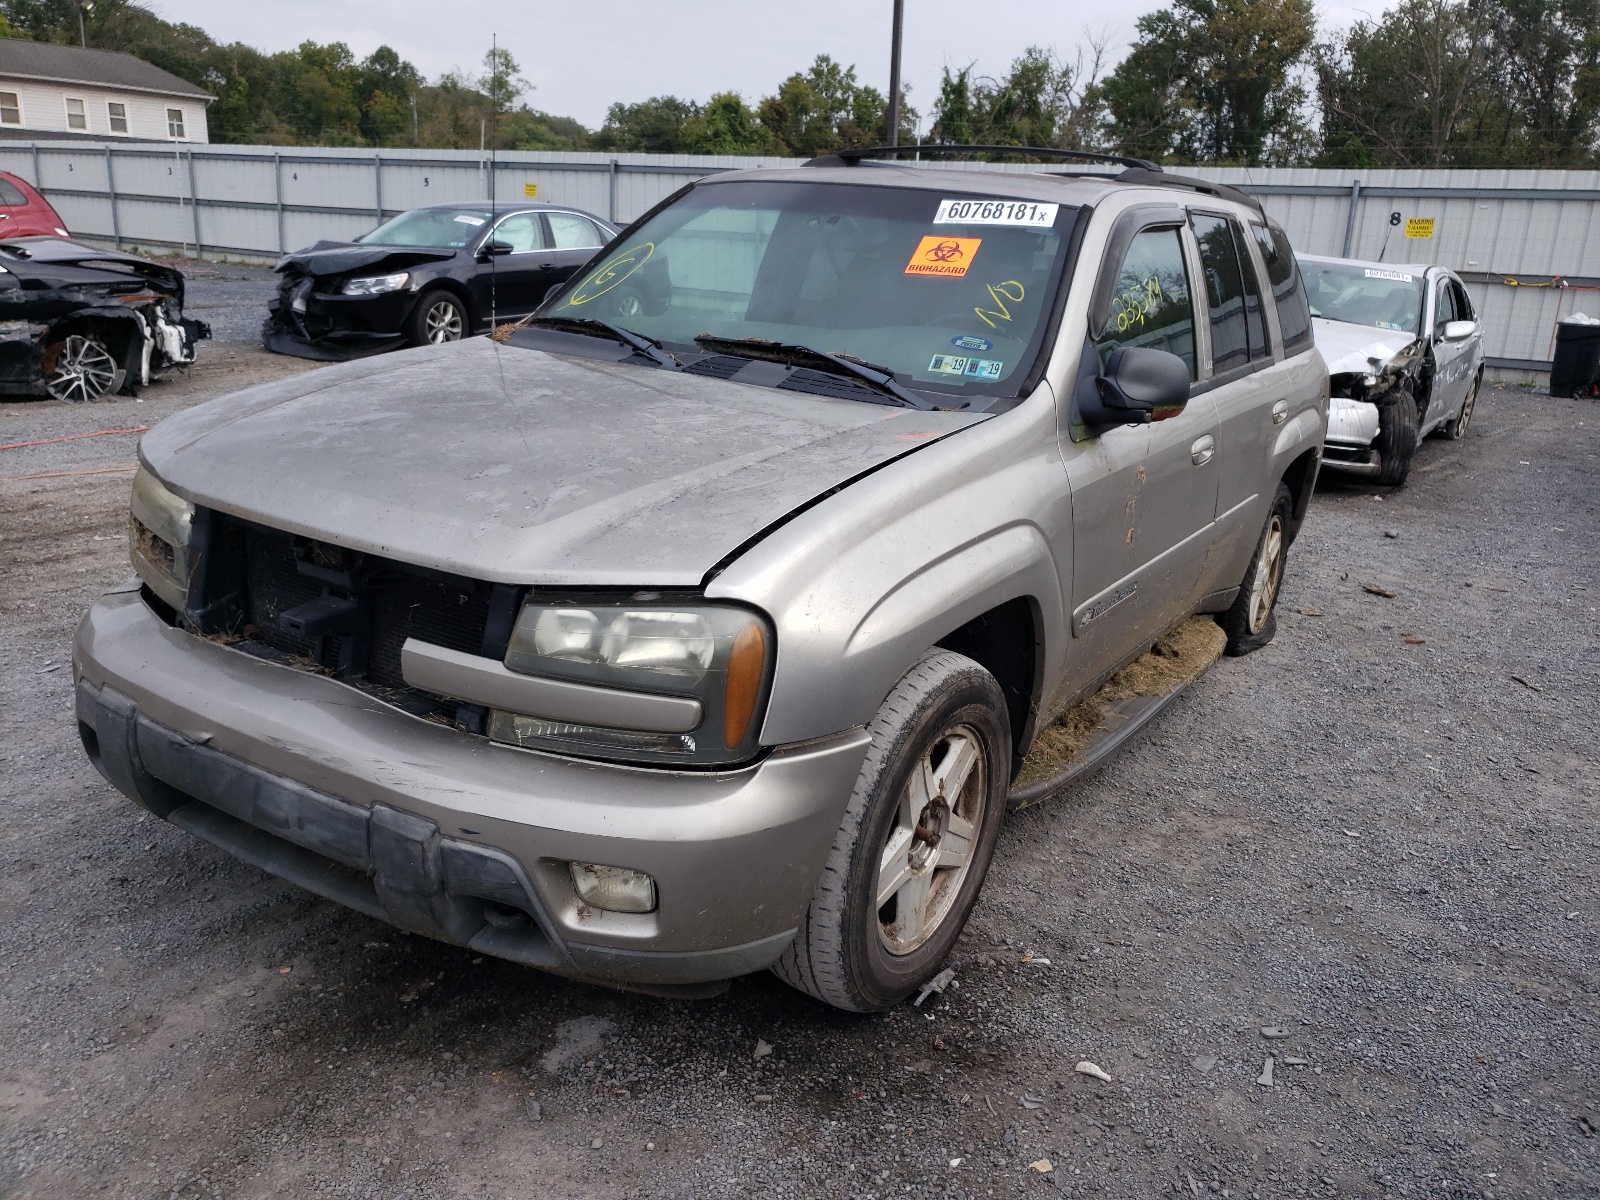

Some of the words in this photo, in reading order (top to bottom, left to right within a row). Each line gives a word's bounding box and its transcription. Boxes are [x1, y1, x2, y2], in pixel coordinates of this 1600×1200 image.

[424, 177, 430, 188] 5
[947, 202, 1038, 221] 60768181
[1390, 212, 1402, 226] 8
[907, 264, 966, 275] BIOHAZARD
[951, 359, 965, 371] 19
[988, 362, 1000, 375] 19
